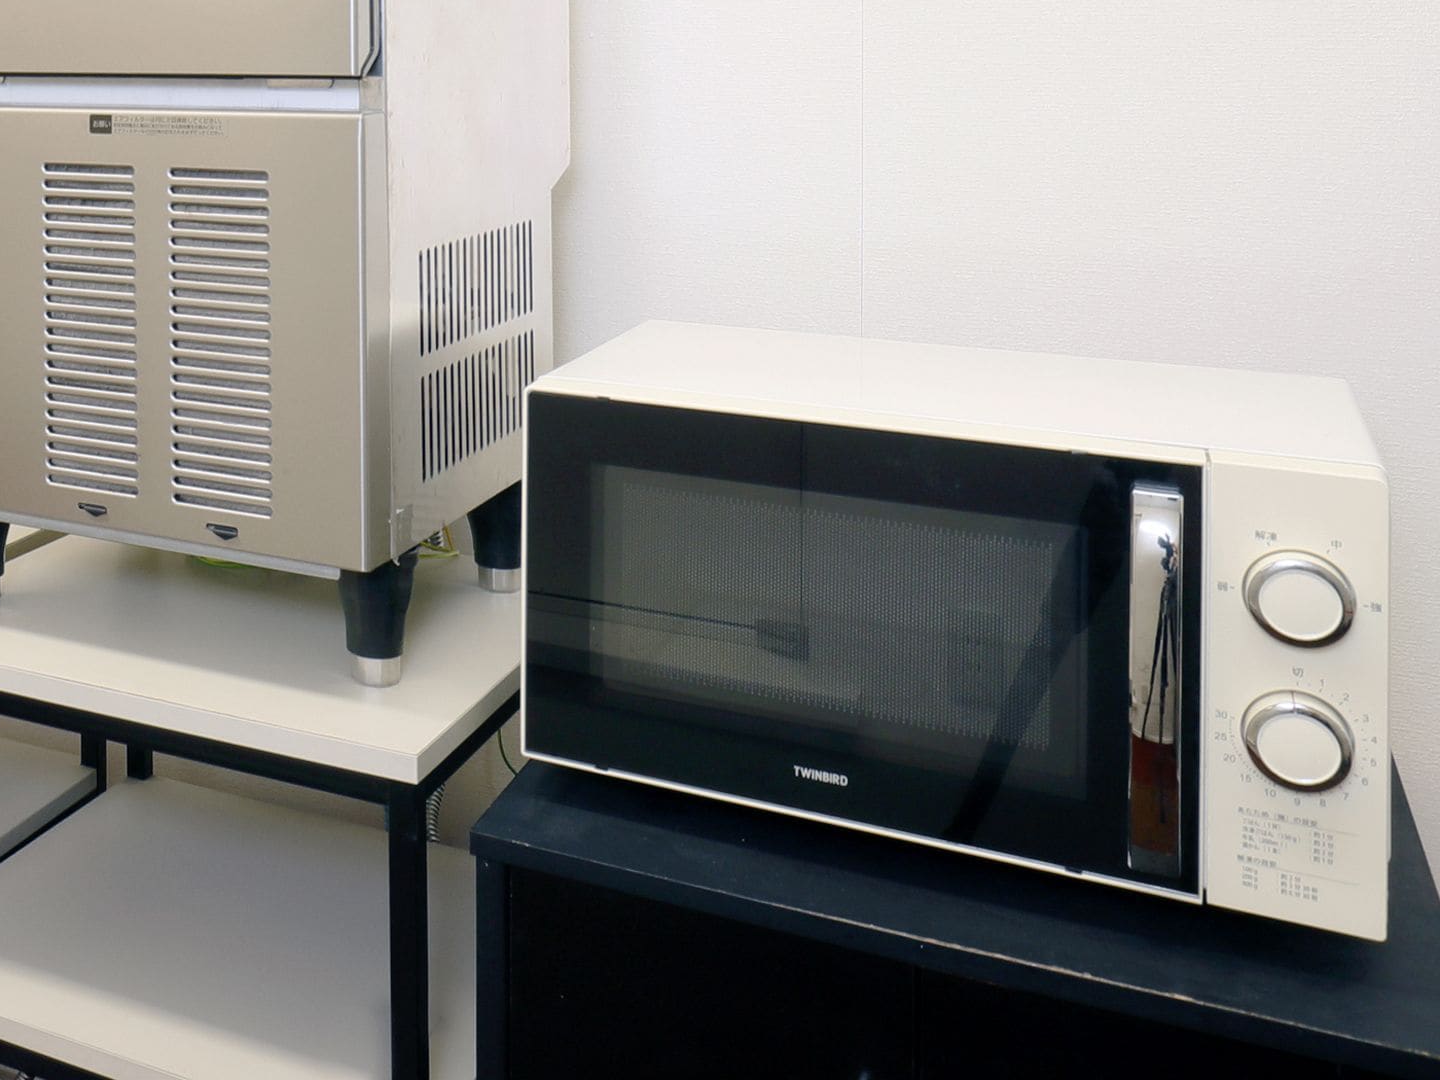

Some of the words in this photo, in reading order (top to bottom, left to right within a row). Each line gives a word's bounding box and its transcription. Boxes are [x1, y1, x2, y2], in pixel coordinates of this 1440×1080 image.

[1254, 529, 1277, 541] 解凍
[1330, 539, 1342, 551] 中
[1292, 667, 1304, 678] 切
[1215, 709, 1228, 720] 30
[1214, 731, 1227, 741] 25
[1223, 752, 1236, 763] 20
[793, 765, 849, 787] TWINBIRD
[1240, 772, 1252, 783] 15
[1264, 788, 1277, 799] 10
